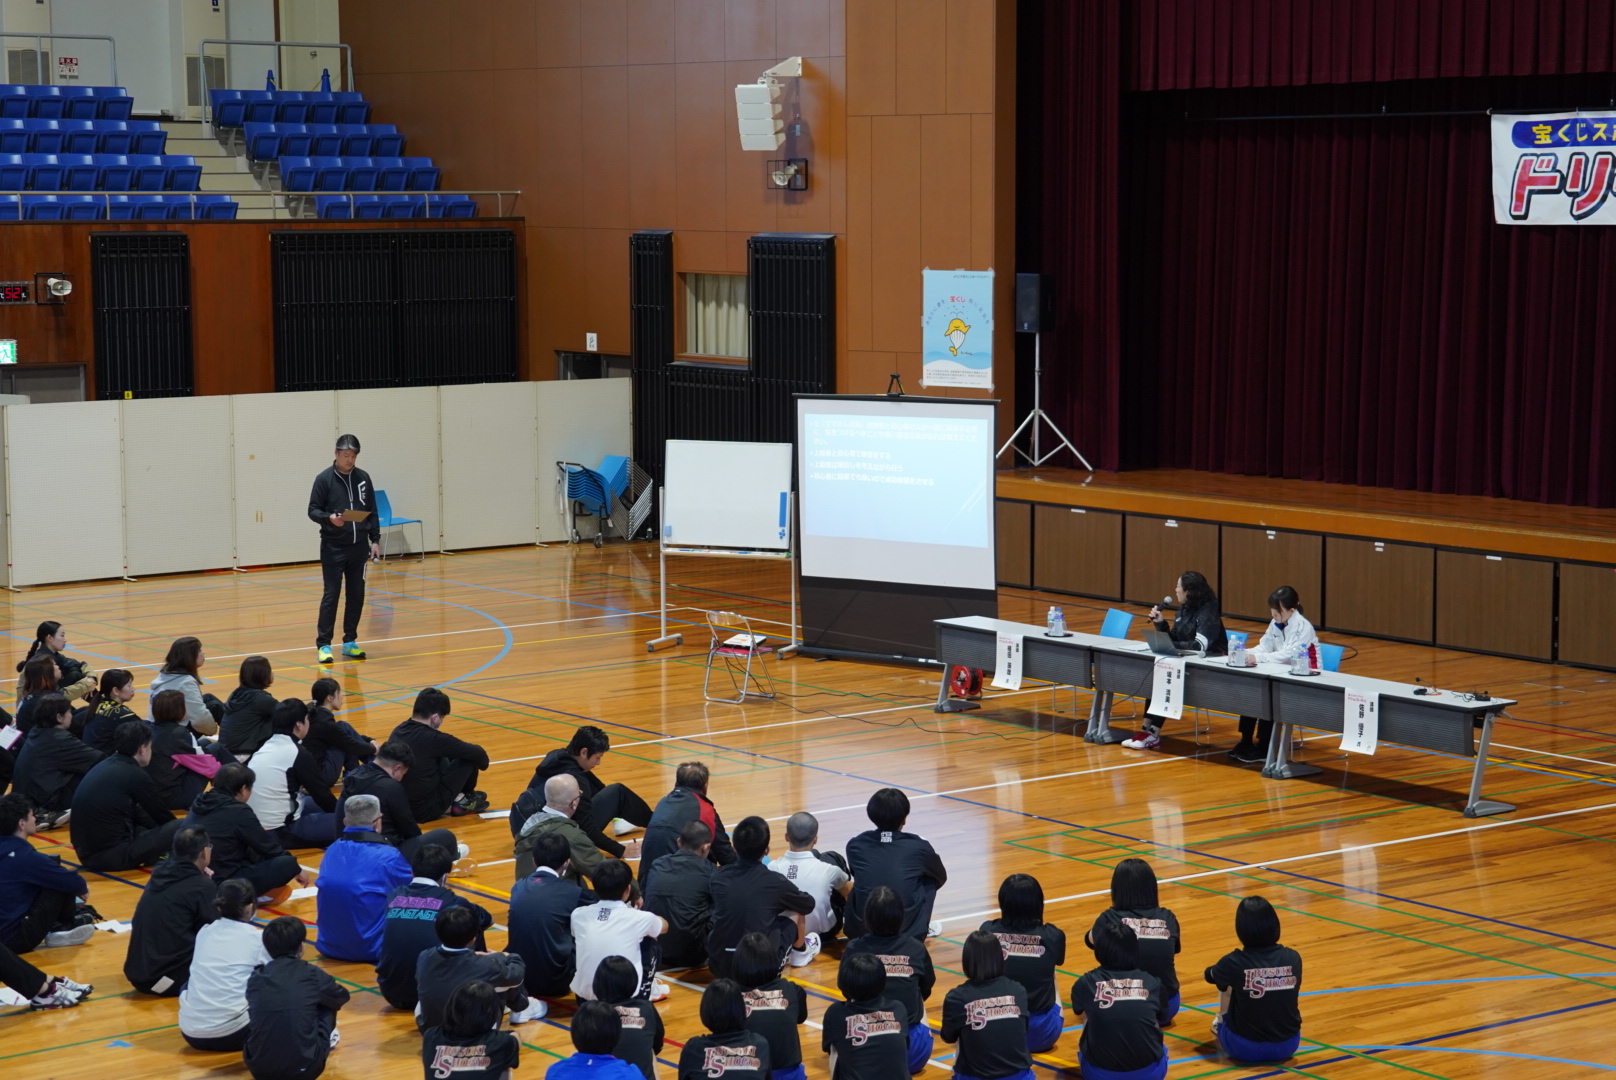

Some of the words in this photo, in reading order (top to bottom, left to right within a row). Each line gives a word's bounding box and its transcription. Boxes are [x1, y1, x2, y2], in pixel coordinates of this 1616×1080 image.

[1532, 124, 1616, 144] 宝くじス
[1509, 152, 1616, 220] ドリ
